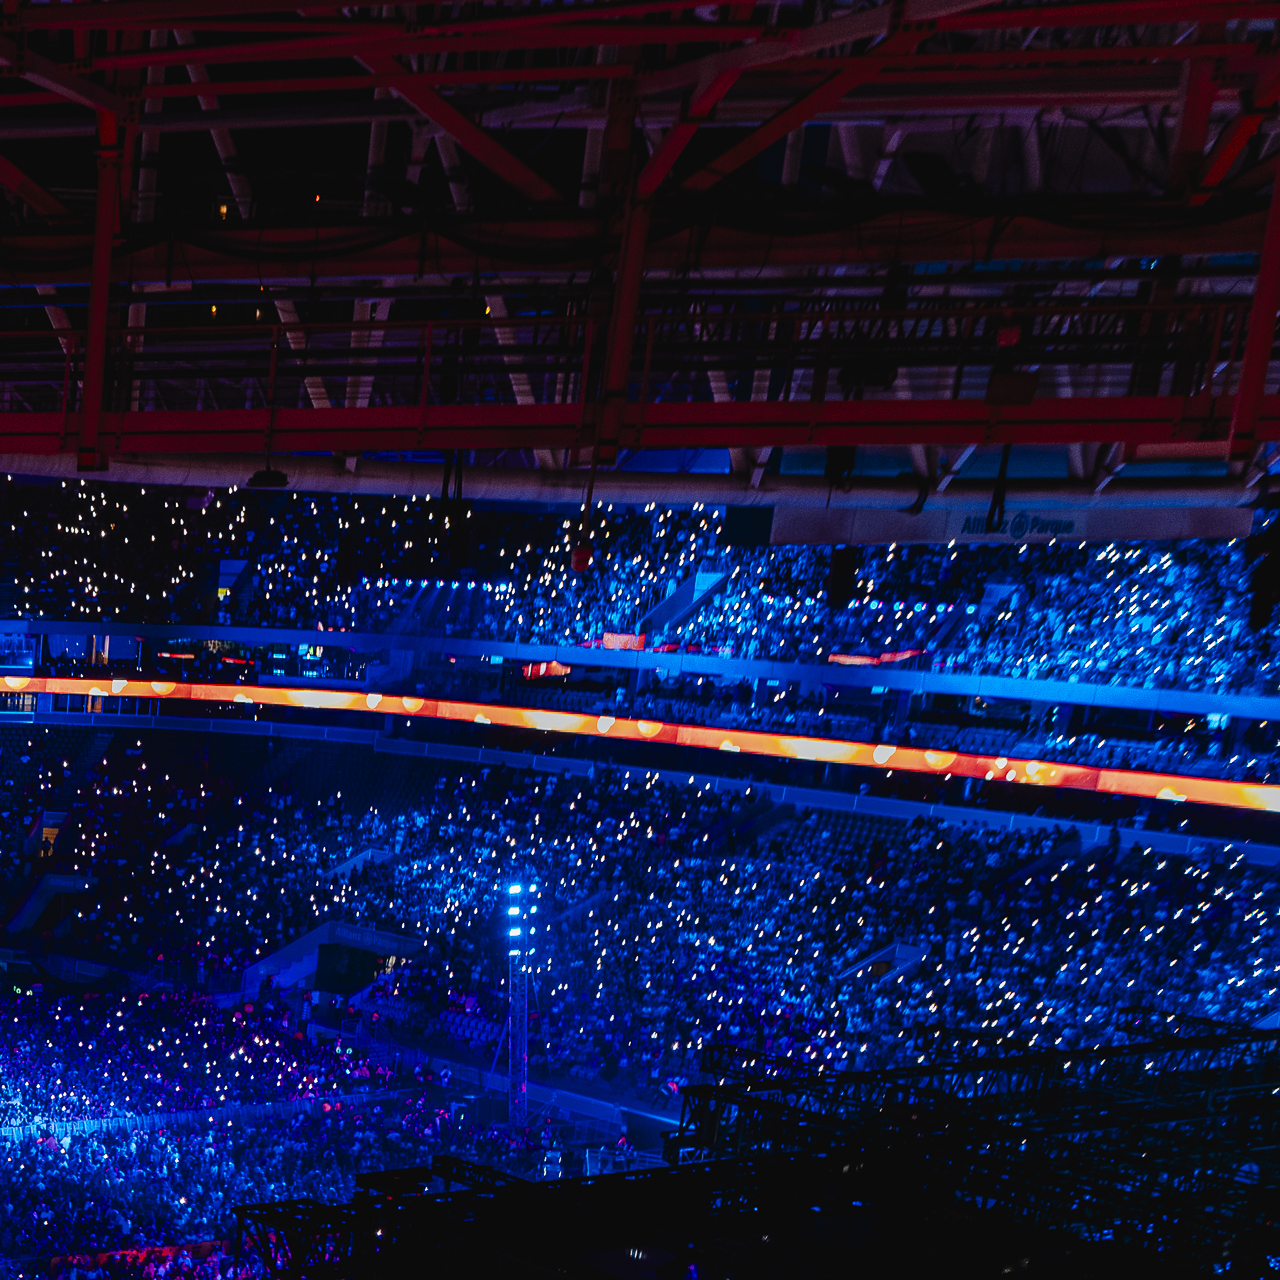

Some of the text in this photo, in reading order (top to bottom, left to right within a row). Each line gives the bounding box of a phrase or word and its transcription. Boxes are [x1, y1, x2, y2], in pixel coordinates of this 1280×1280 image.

[961, 516, 1075, 537] Alliz Parque
[335, 927, 362, 941] Allianz
